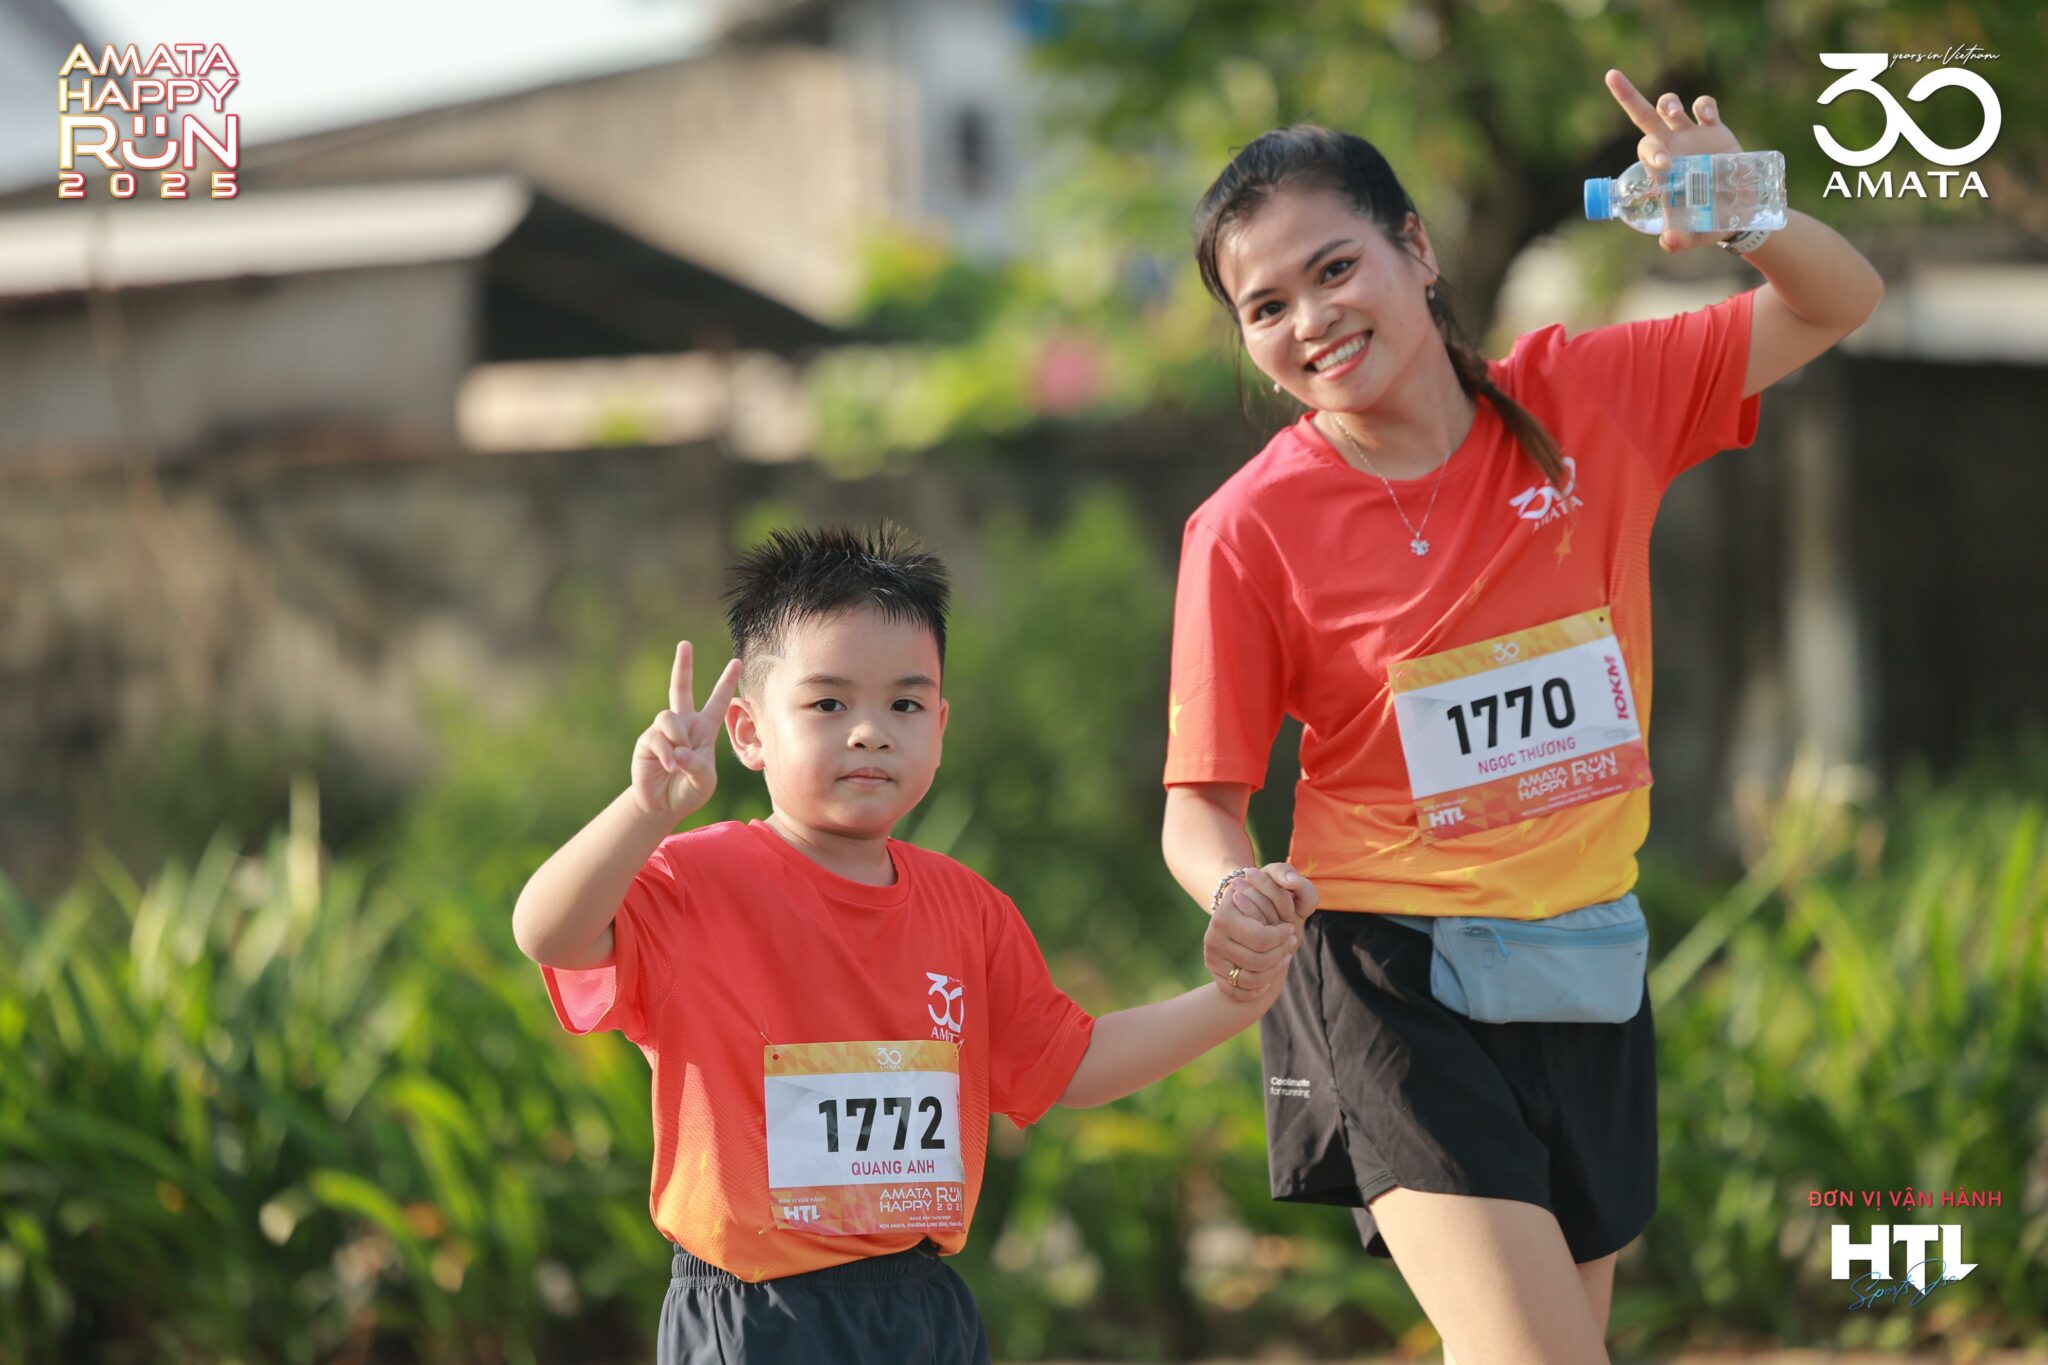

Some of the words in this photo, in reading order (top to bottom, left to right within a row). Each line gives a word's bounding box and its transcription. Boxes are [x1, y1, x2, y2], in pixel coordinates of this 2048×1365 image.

[1603, 655, 1630, 720] 10KM
[1446, 677, 1576, 756] 1770
[1477, 752, 1517, 775] NGỌC
[1519, 736, 1577, 763] THƯƠNG
[1518, 766, 1568, 789] AMATA
[1518, 776, 1568, 801] HAPPY
[1429, 806, 1466, 829] HTL
[1270, 1077, 1311, 1087] Coolmate
[1270, 1086, 1281, 1095] for
[1282, 1088, 1311, 1099] running
[818, 1096, 945, 1152] 1772
[851, 1160, 902, 1175] QUANG
[907, 1159, 935, 1174] ANH
[880, 1187, 932, 1200] AMATA
[783, 1205, 821, 1224] HTL
[880, 1200, 932, 1213] HAPPY
